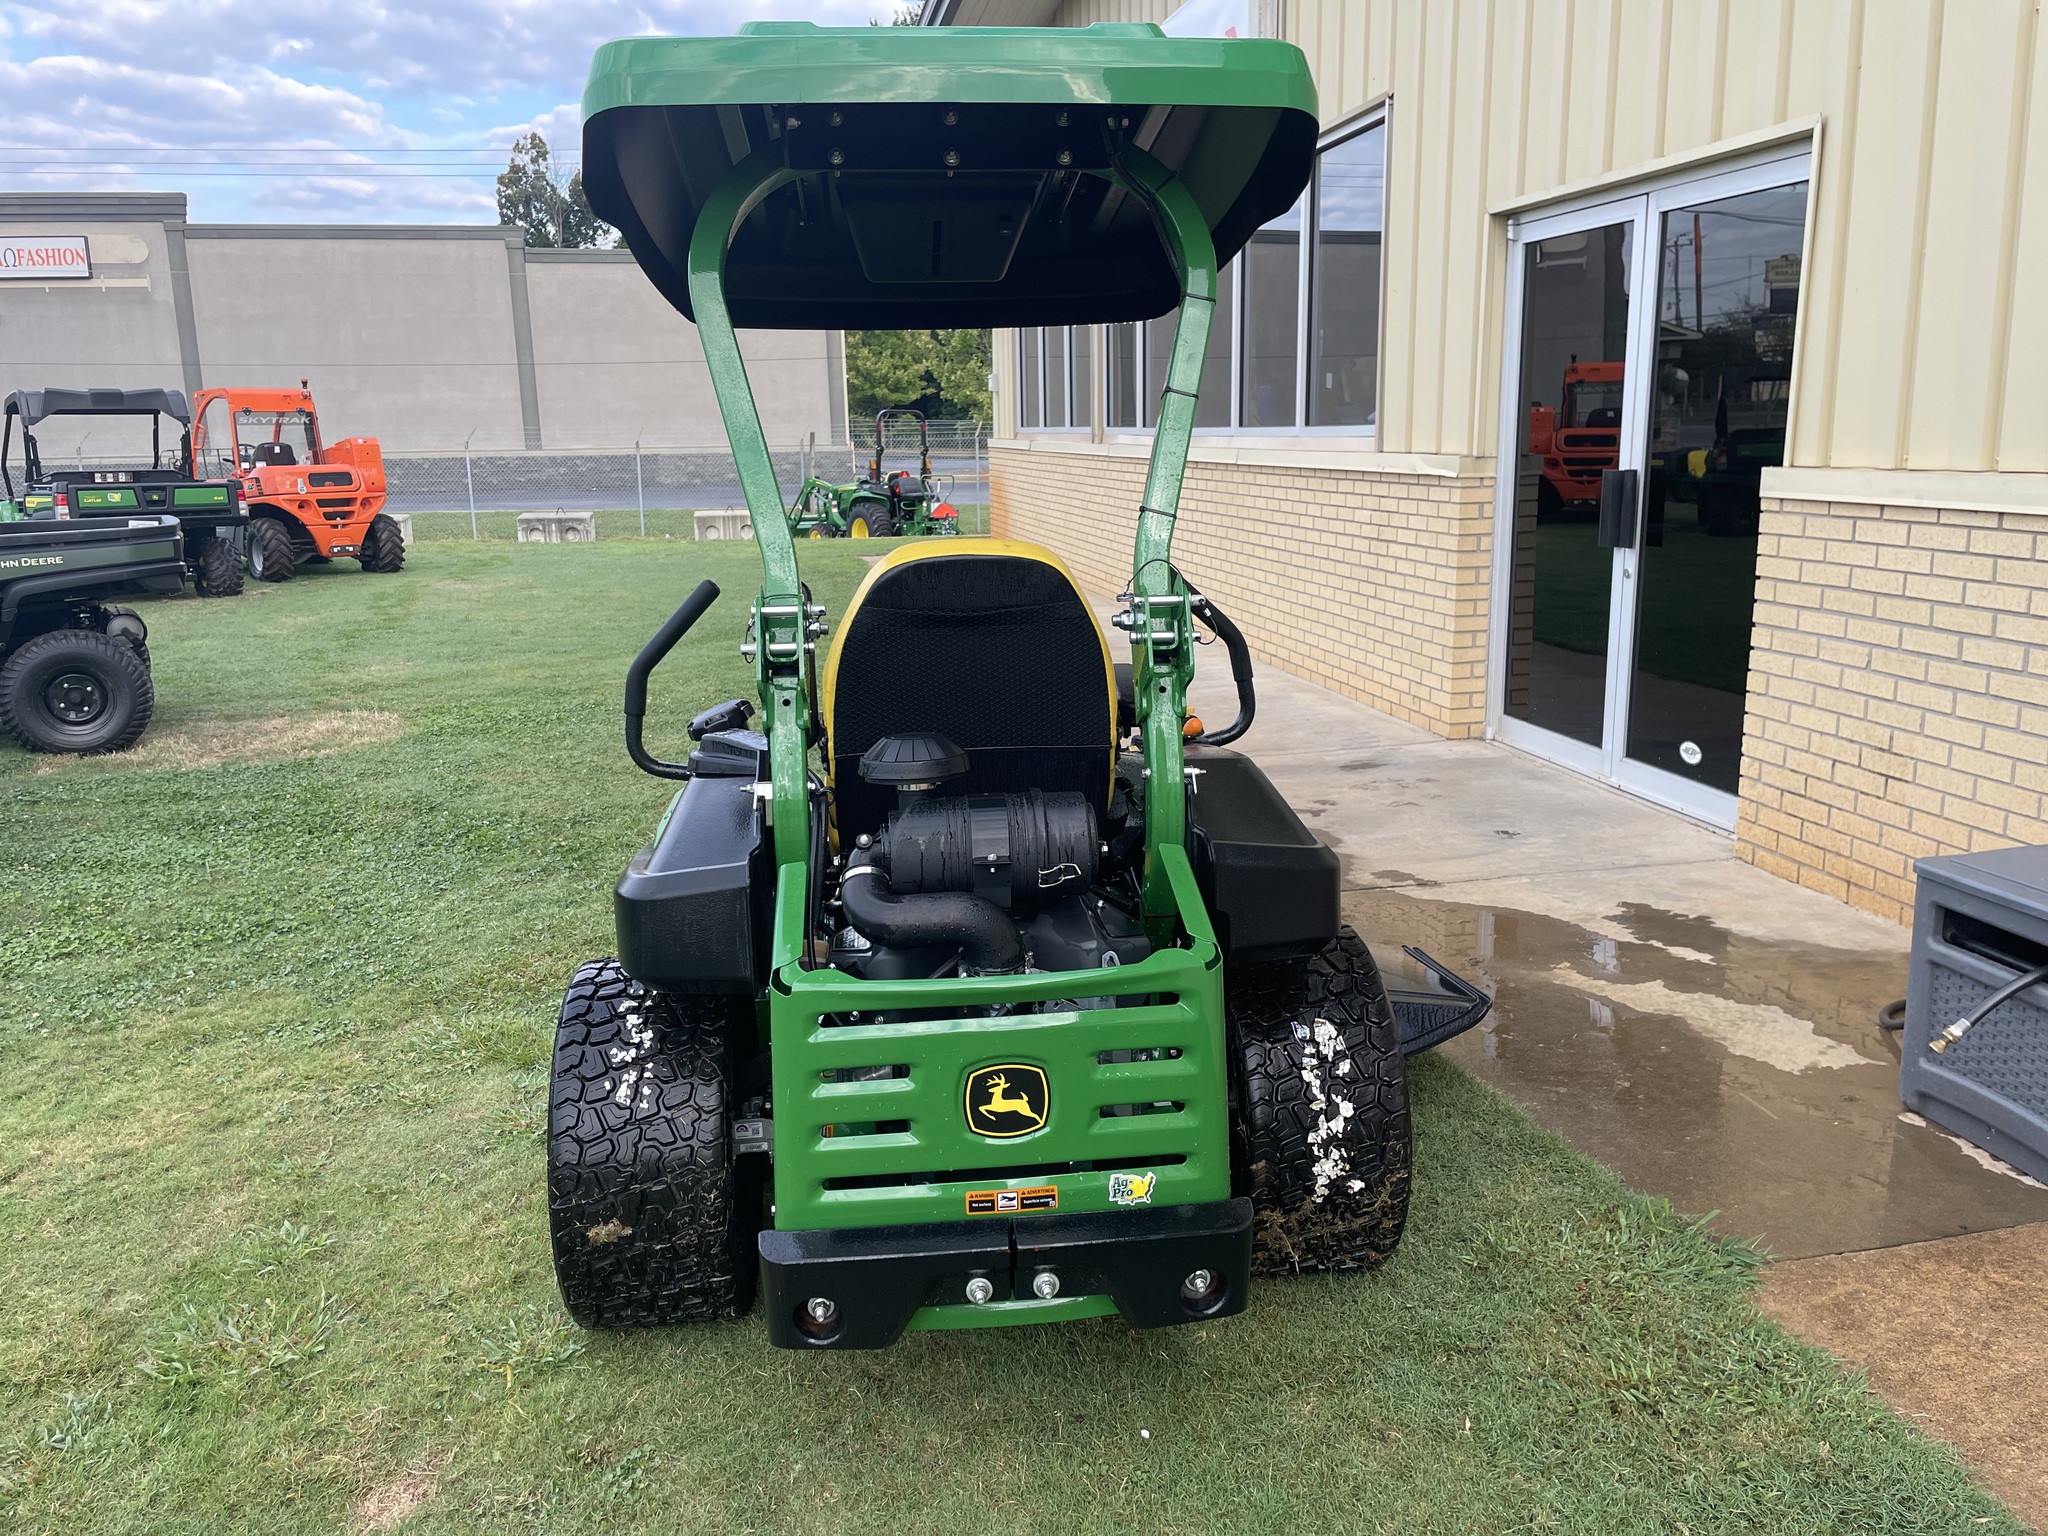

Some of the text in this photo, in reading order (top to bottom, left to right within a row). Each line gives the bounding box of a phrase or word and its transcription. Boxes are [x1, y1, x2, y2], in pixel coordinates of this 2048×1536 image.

[0, 556, 64, 568] HN DEERE
[1113, 1188, 1133, 1198] Pro
